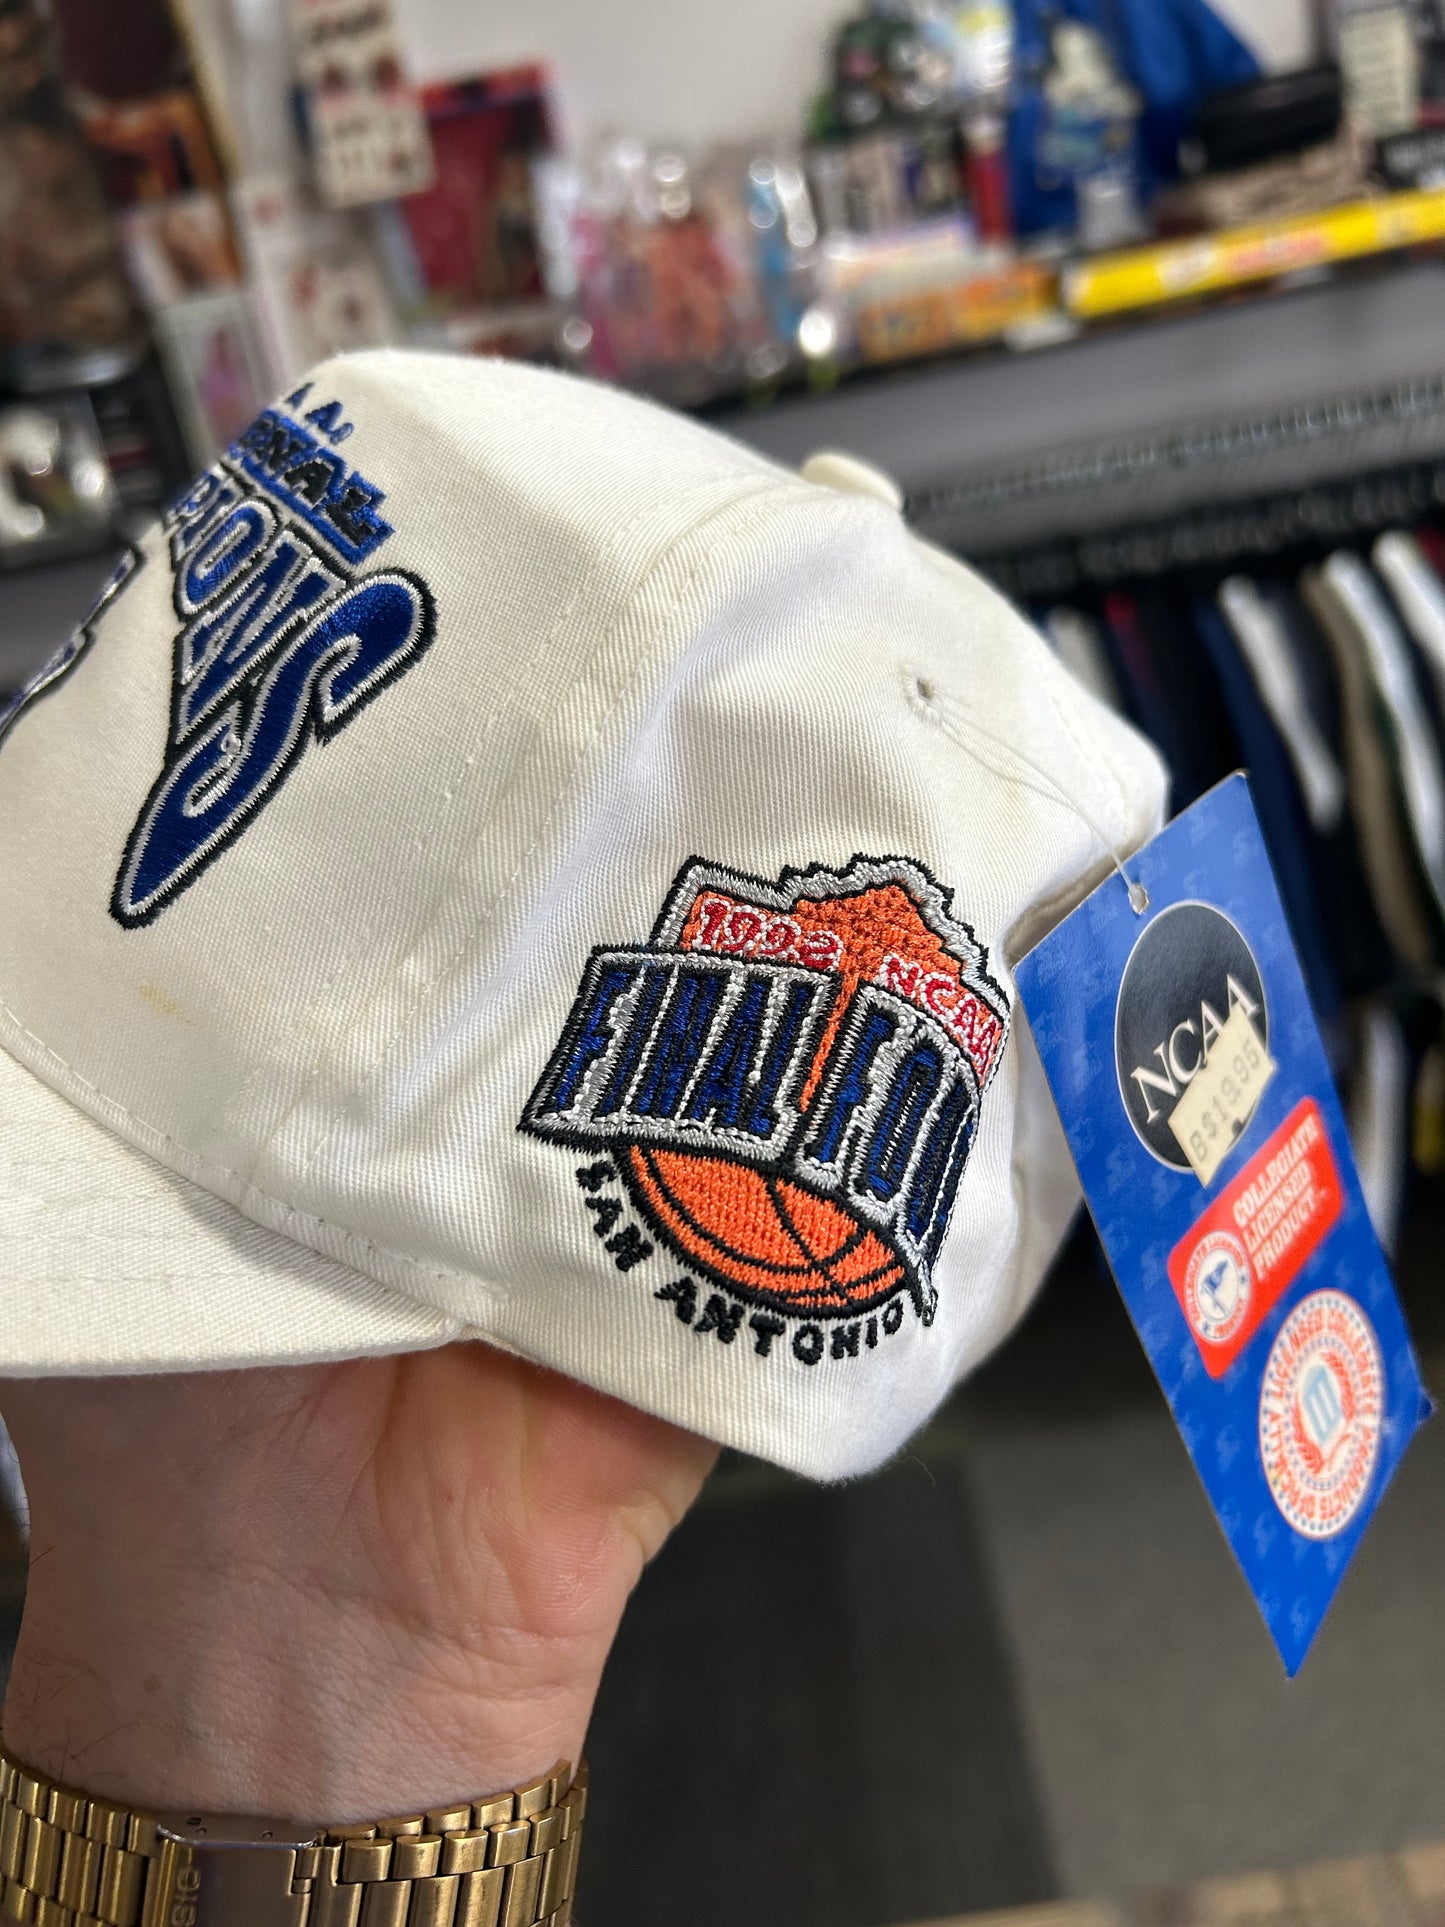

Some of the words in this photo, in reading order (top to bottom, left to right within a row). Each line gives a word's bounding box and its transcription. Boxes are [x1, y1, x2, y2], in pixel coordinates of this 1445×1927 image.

[537, 962, 832, 1145] FINAL
[693, 897, 843, 972] 1992
[872, 951, 1001, 1084] NCAA
[1130, 973, 1259, 1125] NCAA
[1233, 1115, 1319, 1228] COLLEGIATE
[1243, 1158, 1312, 1254] LICENSED
[1253, 1186, 1316, 1282] PRODUCT
[576, 1159, 653, 1273] SAN
[654, 1276, 905, 1366] ANTONIO
